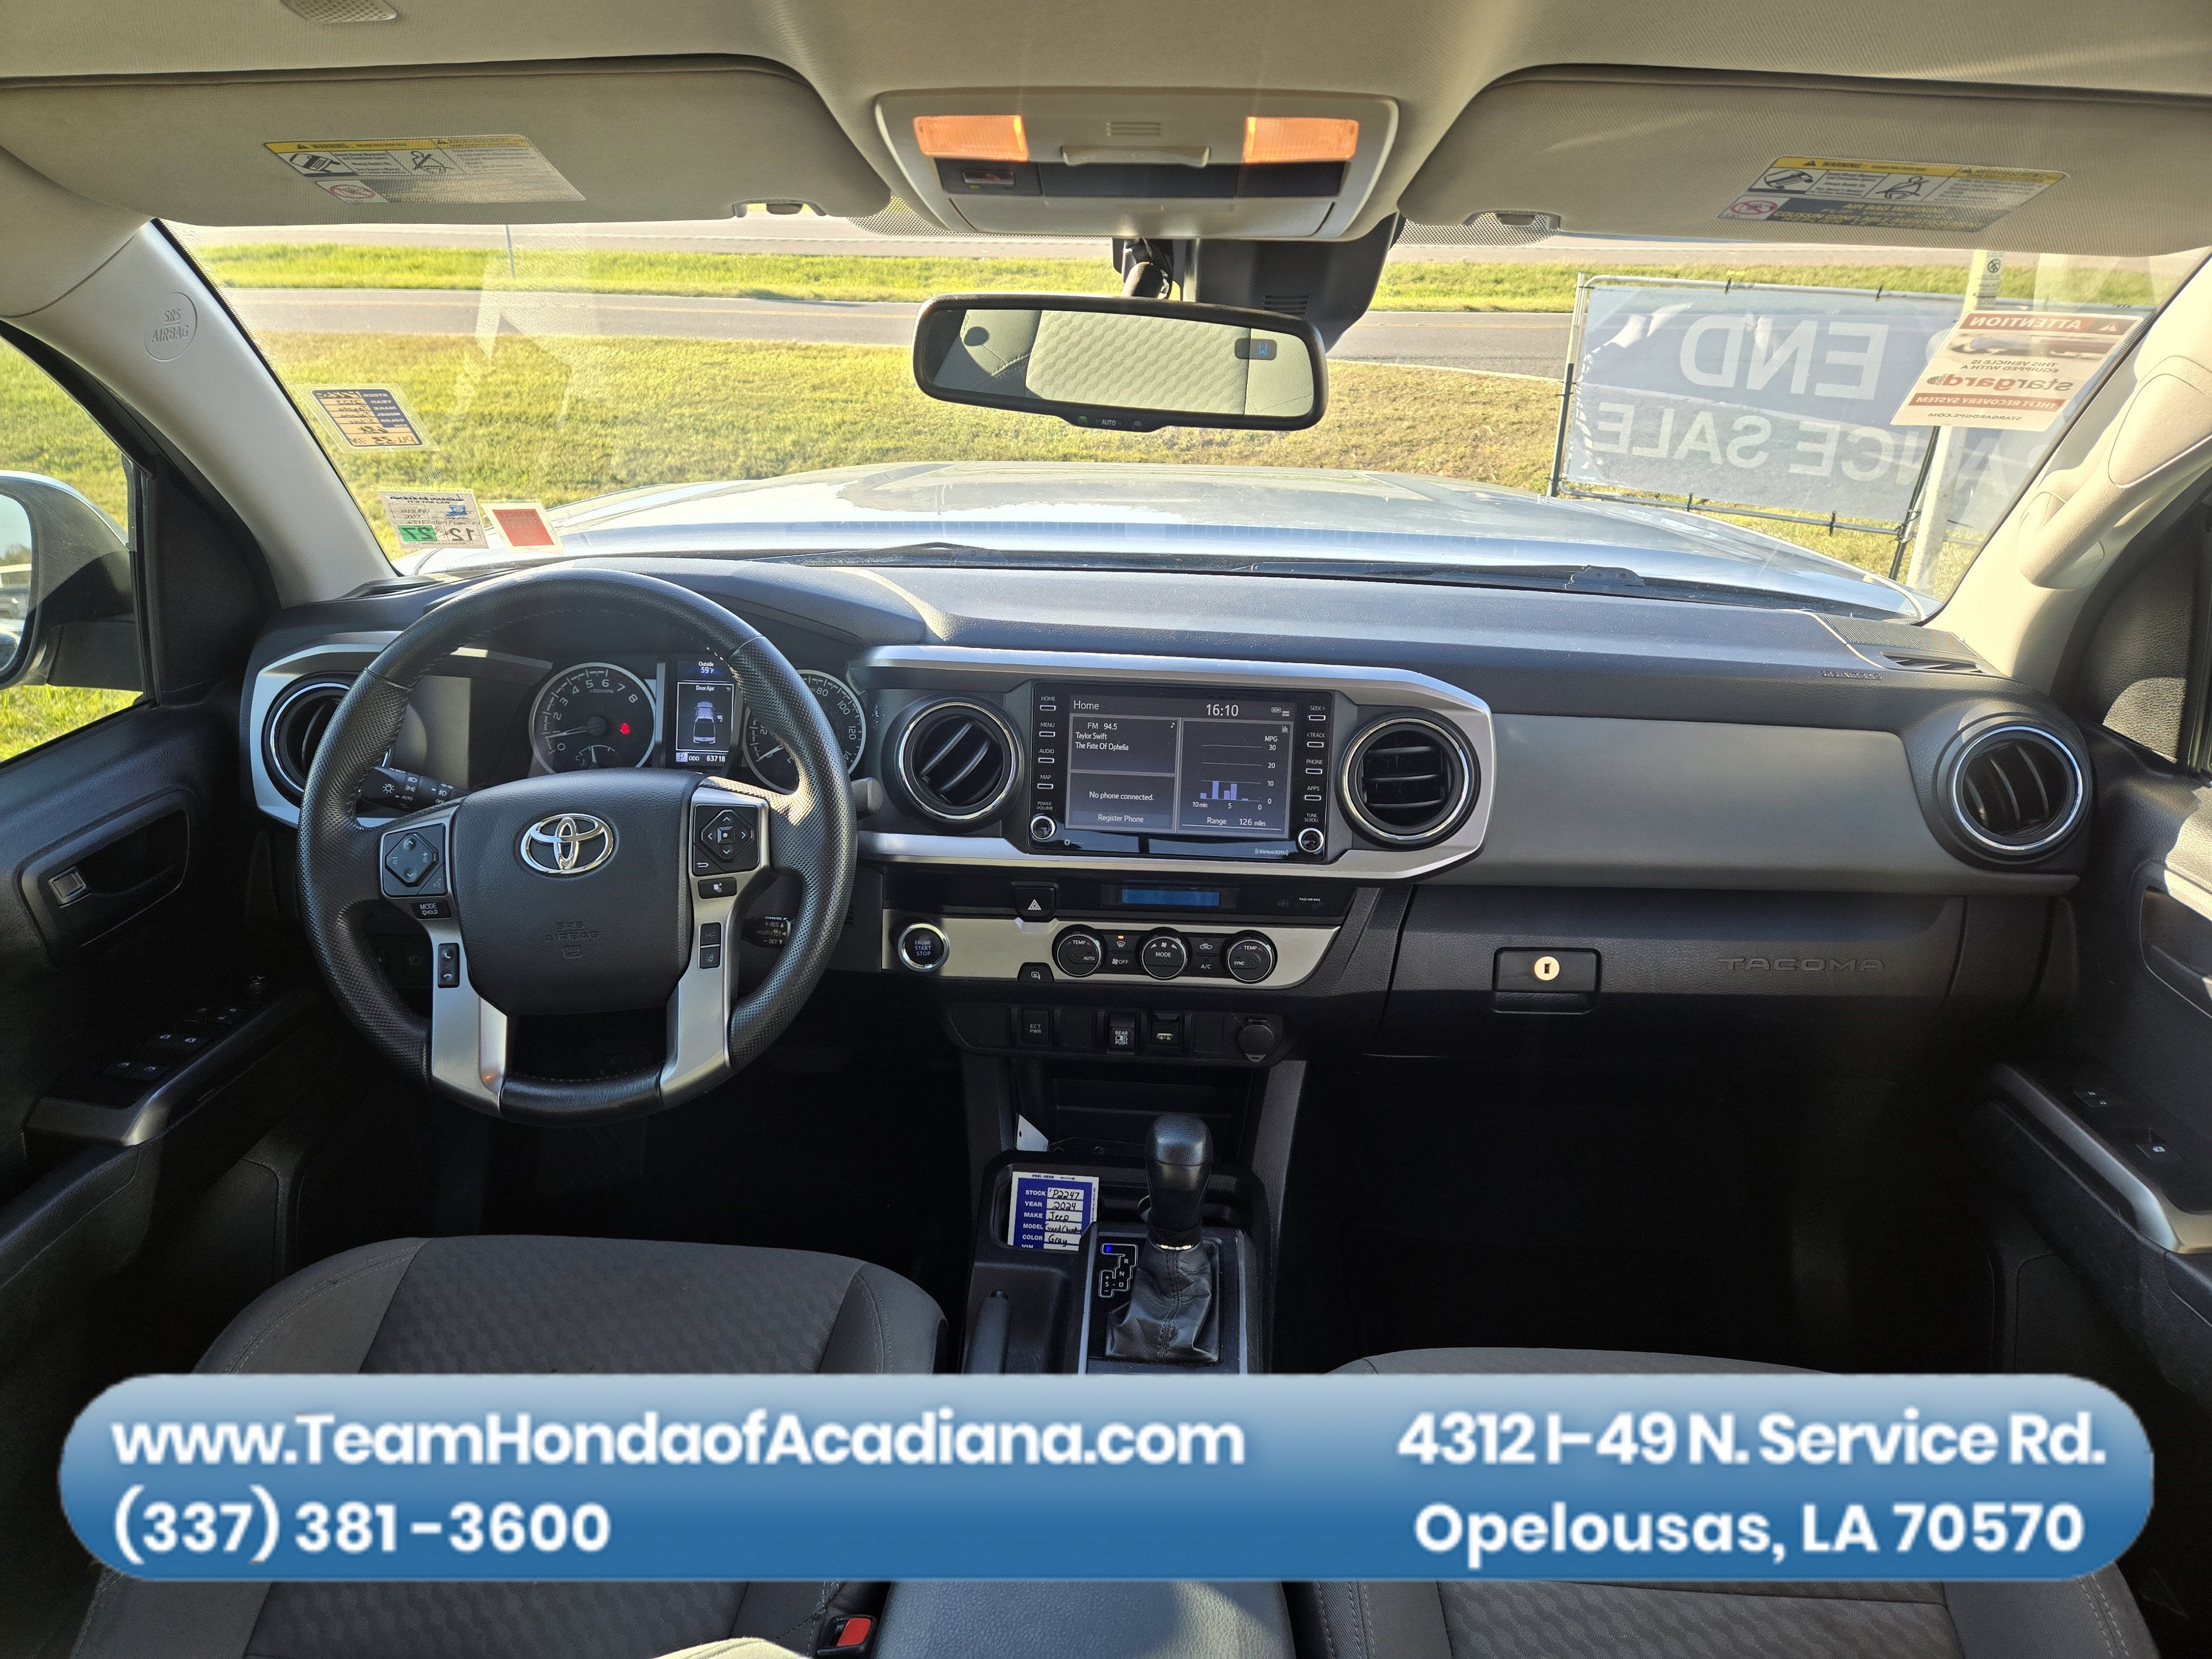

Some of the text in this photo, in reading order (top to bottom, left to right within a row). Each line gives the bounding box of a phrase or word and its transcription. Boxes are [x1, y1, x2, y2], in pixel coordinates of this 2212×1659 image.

[164, 309, 181, 322] SRS
[150, 325, 189, 343] AIRBAG
[586, 679, 594, 688] 5
[602, 679, 609, 687] 6
[617, 683, 626, 692] 7
[572, 685, 580, 695] 4
[816, 687, 828, 697] 80
[559, 697, 568, 706] 3
[628, 693, 638, 703] 8
[837, 701, 851, 715] 100
[1073, 700, 1239, 717] Home 16:10
[553, 712, 562, 721] 2
[848, 726, 857, 740] 120
[1076, 732, 1092, 740] Taylor
[1108, 743, 1129, 752] Ophelia
[1098, 814, 1123, 822] Register
[1207, 817, 1227, 825] Range
[1717, 957, 1886, 973] TACOMA
[1052, 1189, 1079, 1199] P2247
[1052, 1202, 1076, 1210] 2024
[1048, 1211, 1069, 1223] Jeep
[1048, 1234, 1068, 1247] Gray
